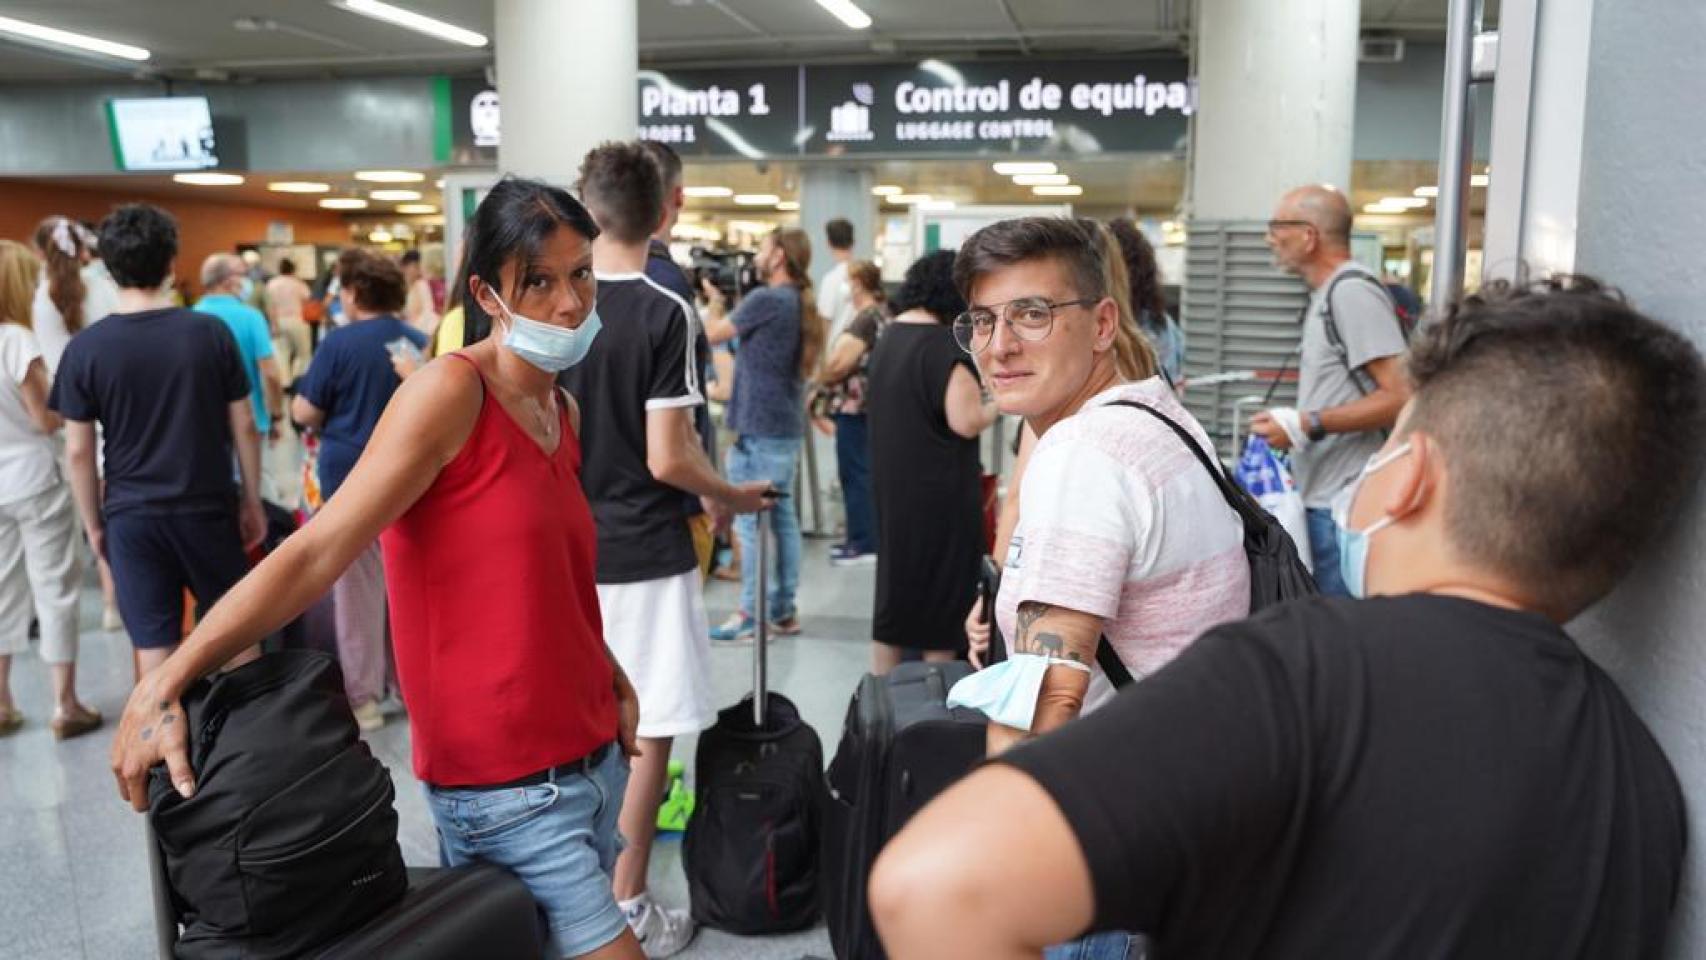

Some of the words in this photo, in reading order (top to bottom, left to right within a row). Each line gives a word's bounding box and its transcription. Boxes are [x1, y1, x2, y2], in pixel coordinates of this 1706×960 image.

[641, 86, 739, 116] Planta
[749, 84, 770, 116] 1
[895, 80, 1009, 113] Control
[1019, 78, 1062, 111] de
[896, 121, 974, 140] LUGGAGE
[978, 119, 1053, 139] CONTROL
